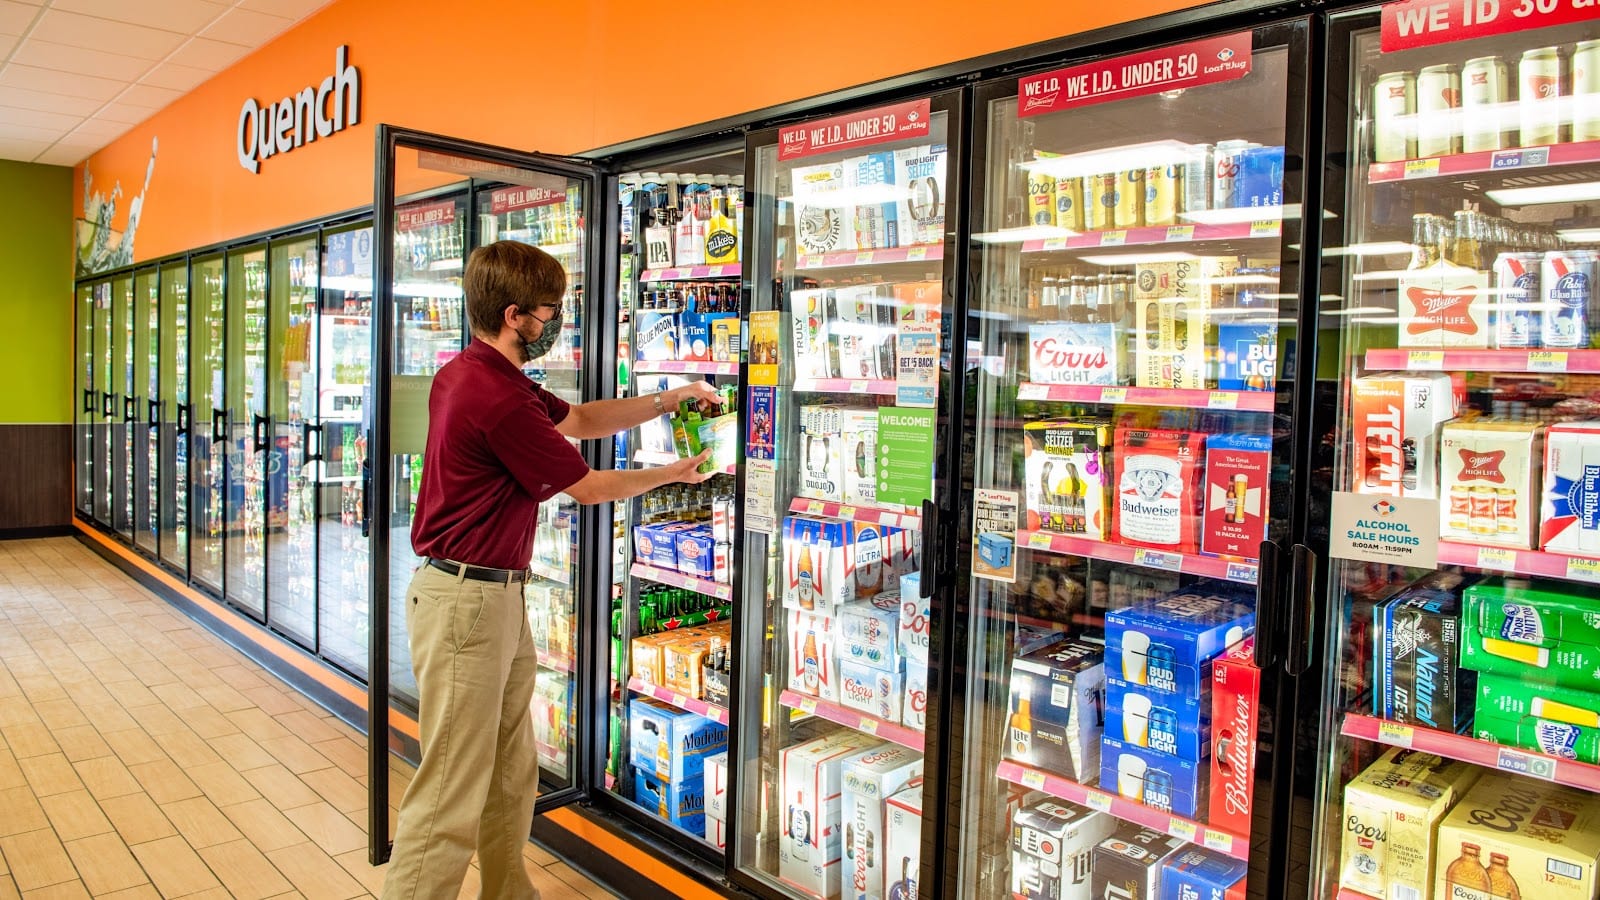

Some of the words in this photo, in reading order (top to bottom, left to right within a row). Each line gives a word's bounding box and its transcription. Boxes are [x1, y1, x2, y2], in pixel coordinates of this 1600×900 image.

[1396, 3, 1449, 37] WE
[1463, 0, 1499, 26] ID
[1067, 75, 1089, 98] WE
[1092, 72, 1117, 93] I.D.
[1122, 58, 1173, 88] UNDER
[1177, 53, 1198, 77] 50
[1024, 81, 1041, 97] WE
[1043, 77, 1061, 94] I.D.
[237, 44, 362, 174] Quench
[783, 132, 795, 144] WE
[795, 130, 807, 143] I.D.
[811, 128, 826, 147] WE
[827, 125, 844, 144] I.D.
[846, 118, 880, 140] UNDER
[883, 114, 896, 133] 50
[905, 158, 918, 167] BUD
[919, 154, 938, 165] LIGHT
[707, 234, 735, 251] mike's
[649, 240, 670, 263] IPA
[1444, 316, 1467, 325] LIFE
[637, 328, 654, 350] BLUE
[653, 315, 673, 337] MOON
[690, 326, 705, 336] Tire
[796, 317, 805, 357] TRULY
[1033, 338, 1109, 369] Coors
[1248, 344, 1277, 361] BU
[900, 357, 910, 368] GET
[918, 357, 934, 368] BACK
[1240, 361, 1276, 377] LIG
[1051, 370, 1090, 382] LIGHT
[880, 415, 932, 428] WELCOME!
[1045, 435, 1074, 448] SELTZER
[1444, 440, 1453, 448] 12
[1044, 446, 1075, 457] LEMONADE
[1178, 447, 1190, 456] 12
[1366, 404, 1401, 497] TECAT
[1482, 469, 1498, 477] LIFE
[1585, 466, 1600, 490] Blue
[1122, 498, 1179, 517] Budweiser
[1583, 491, 1599, 529] Ribbon
[1356, 519, 1411, 533] ALCOHOL
[1221, 531, 1236, 539] PACK
[1236, 533, 1250, 541] CAN
[1347, 530, 1376, 541] SALE
[1379, 533, 1420, 546] HOURS
[1352, 541, 1379, 550] 8:00AM
[1385, 545, 1412, 554] 11:59PM
[856, 549, 881, 564] ULTRA
[1144, 556, 1163, 565] 11.99
[1228, 569, 1250, 579] 11.99
[1511, 617, 1524, 638] ROCK
[1522, 606, 1537, 641] ROLLING
[911, 633, 929, 648] LIG
[1149, 666, 1174, 681] BUD
[845, 678, 873, 699] Coors
[1147, 675, 1177, 692] LIGHT
[1415, 647, 1439, 729] Natural
[848, 693, 871, 705] LIGHT
[1394, 684, 1409, 714] ICE
[683, 727, 724, 750] Modelo
[1013, 731, 1029, 743] Lite
[1151, 728, 1175, 744] BUD
[1554, 725, 1570, 746] ROCK
[1148, 738, 1177, 755] LIGHT
[1226, 693, 1251, 816] Budweiser
[1499, 758, 1527, 771] 10.99
[1146, 789, 1170, 805] BUD
[856, 801, 867, 846] LIGHT
[1395, 811, 1406, 822] 18
[1347, 815, 1387, 842] Coors
[853, 848, 866, 892] Coors
[1544, 872, 1556, 882] 12
